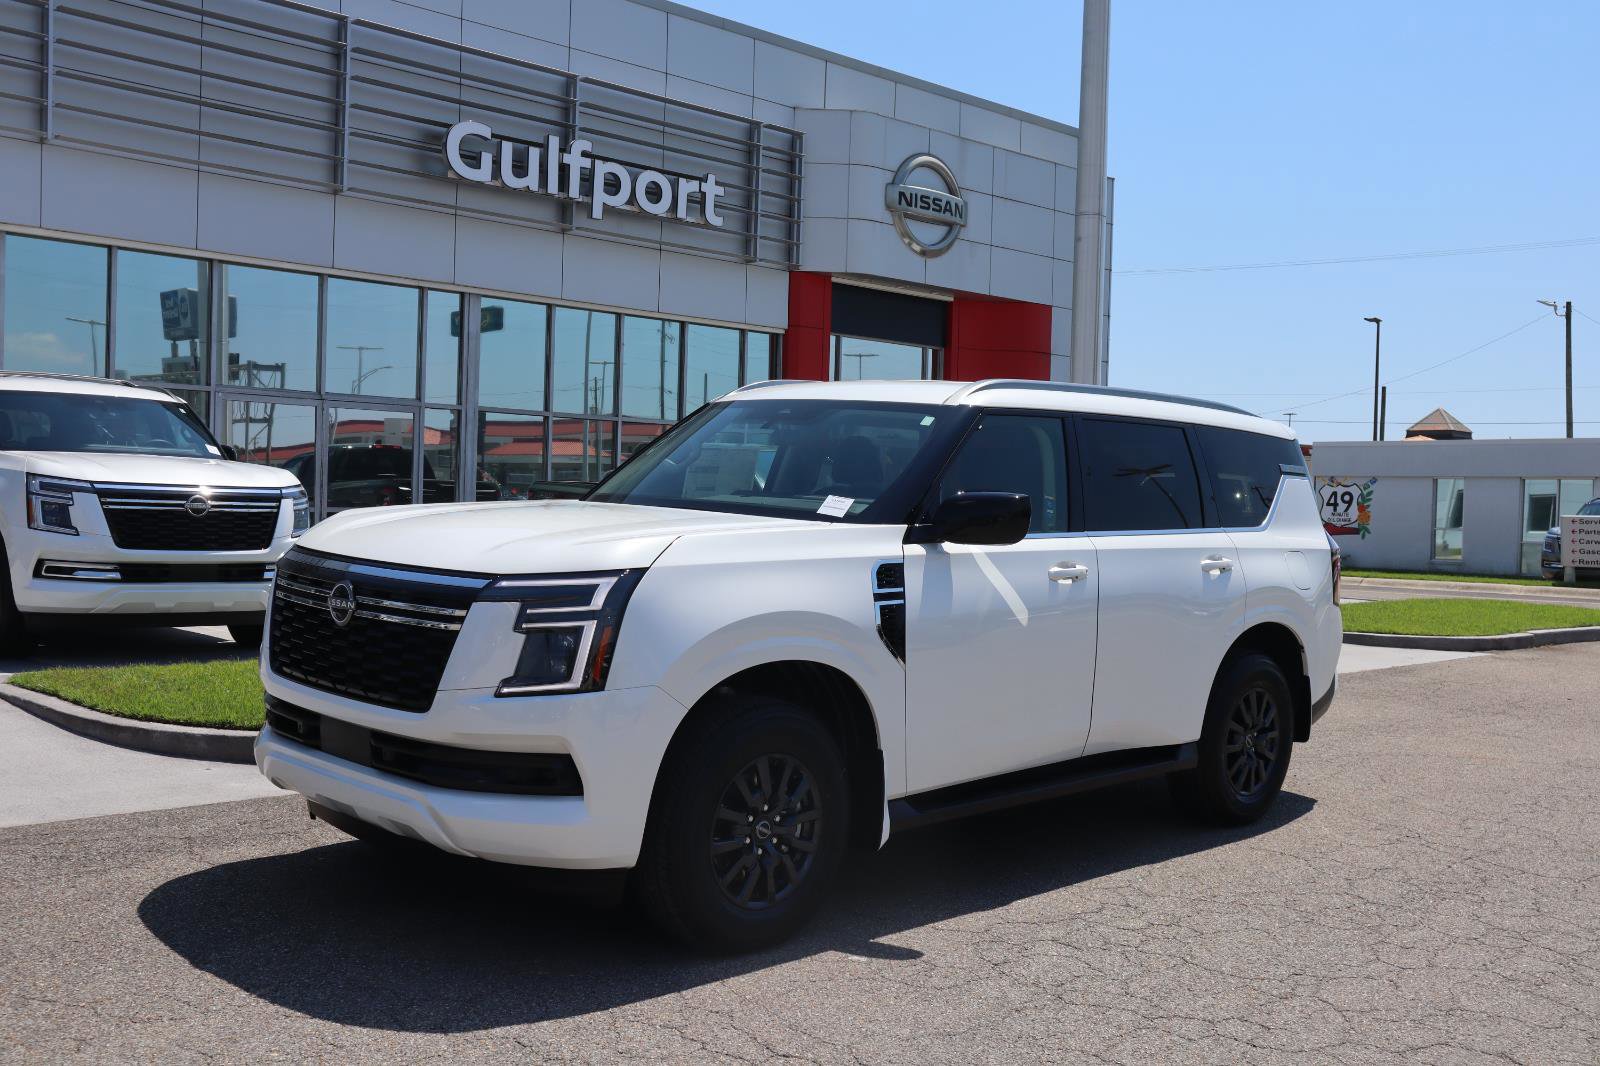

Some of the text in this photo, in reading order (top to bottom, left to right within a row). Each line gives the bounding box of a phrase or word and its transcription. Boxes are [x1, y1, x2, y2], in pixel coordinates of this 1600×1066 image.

[446, 120, 725, 227] Gulfport
[898, 191, 964, 220] NISSAN
[1326, 491, 1354, 512] 49
